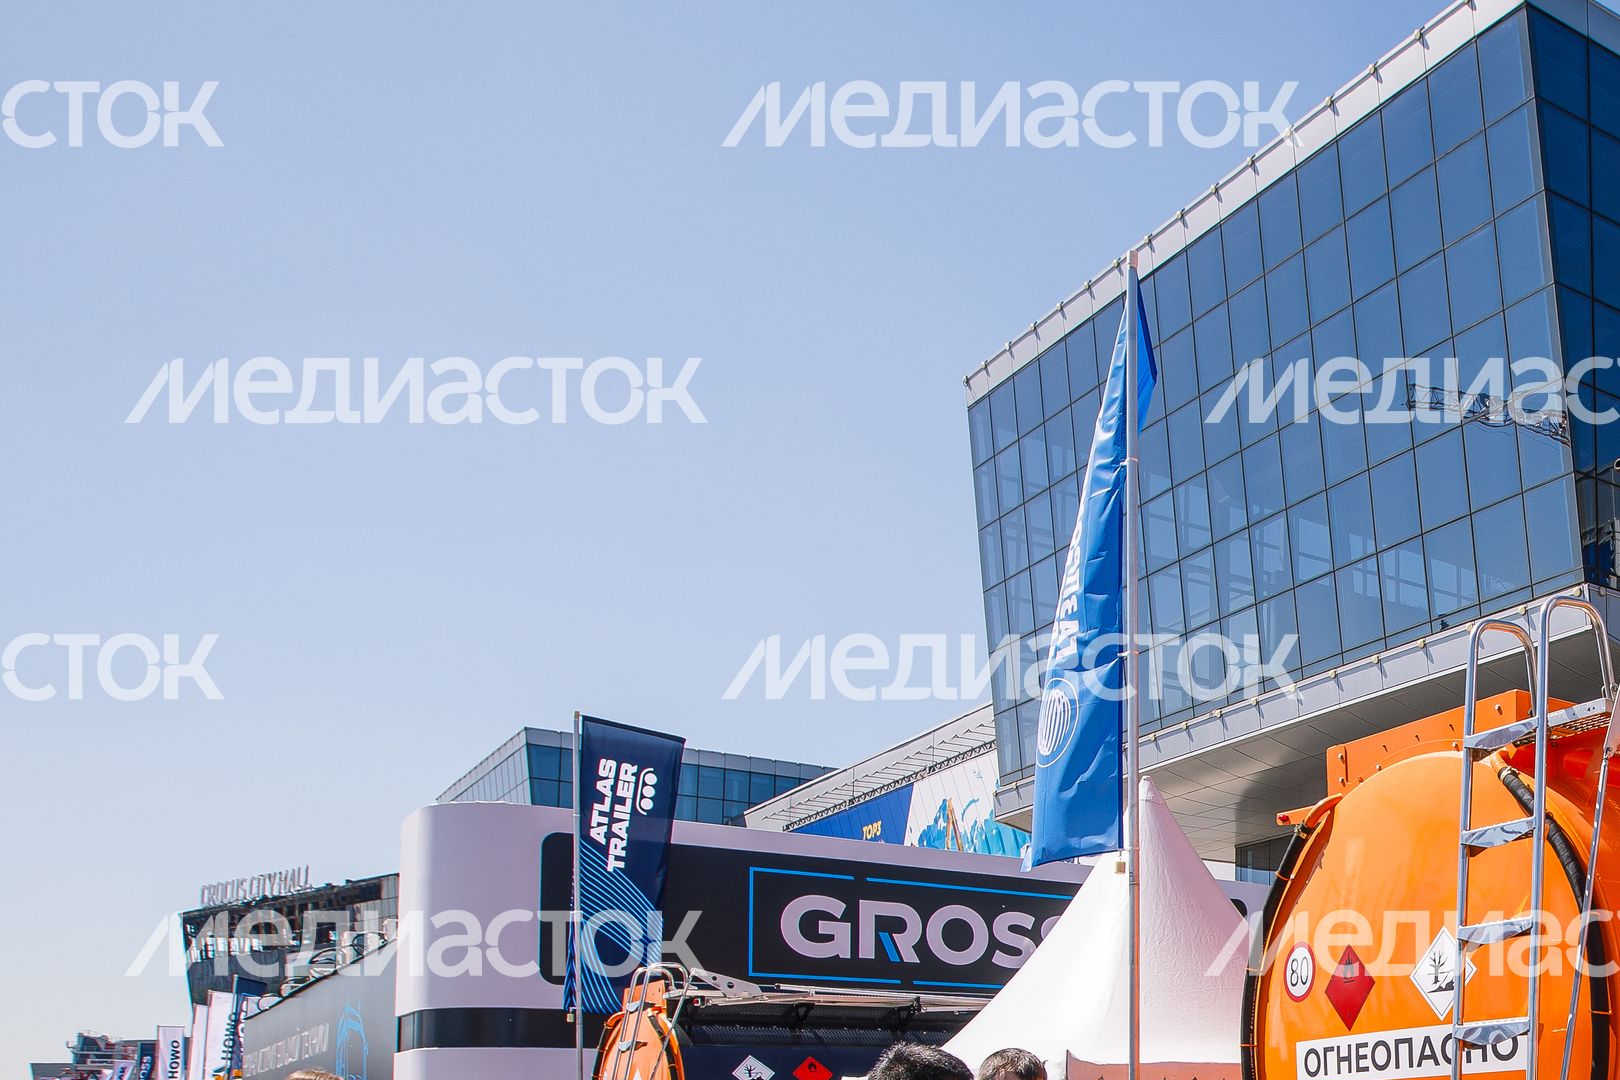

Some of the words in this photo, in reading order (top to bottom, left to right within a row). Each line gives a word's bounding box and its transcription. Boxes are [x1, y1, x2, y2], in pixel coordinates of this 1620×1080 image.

[589, 758, 617, 846] ATLAS
[606, 762, 638, 872] TRAILER
[201, 877, 248, 906] CROCUS
[249, 871, 277, 898] CITY
[278, 864, 312, 894] HALL
[780, 894, 1061, 969] GROS
[1290, 956, 1309, 987] 80
[168, 1040, 180, 1079] HOWO
